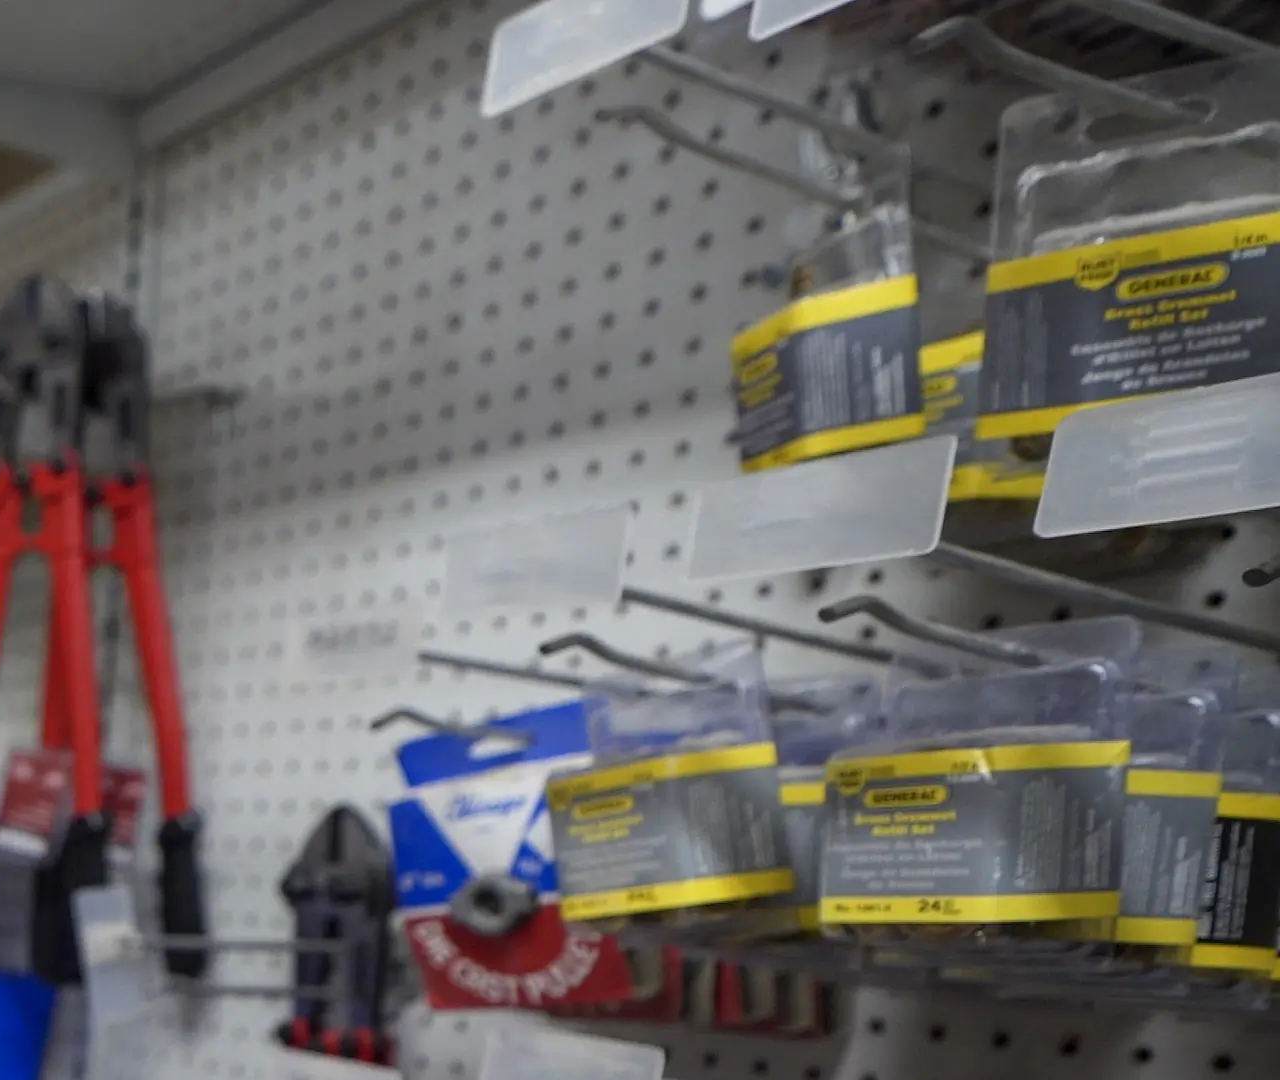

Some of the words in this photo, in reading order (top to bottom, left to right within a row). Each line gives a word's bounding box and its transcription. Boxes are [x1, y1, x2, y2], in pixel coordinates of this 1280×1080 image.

[1128, 270, 1215, 294] GENERAL
[1179, 308, 1210, 323] Set
[872, 788, 937, 804] GENERAL
